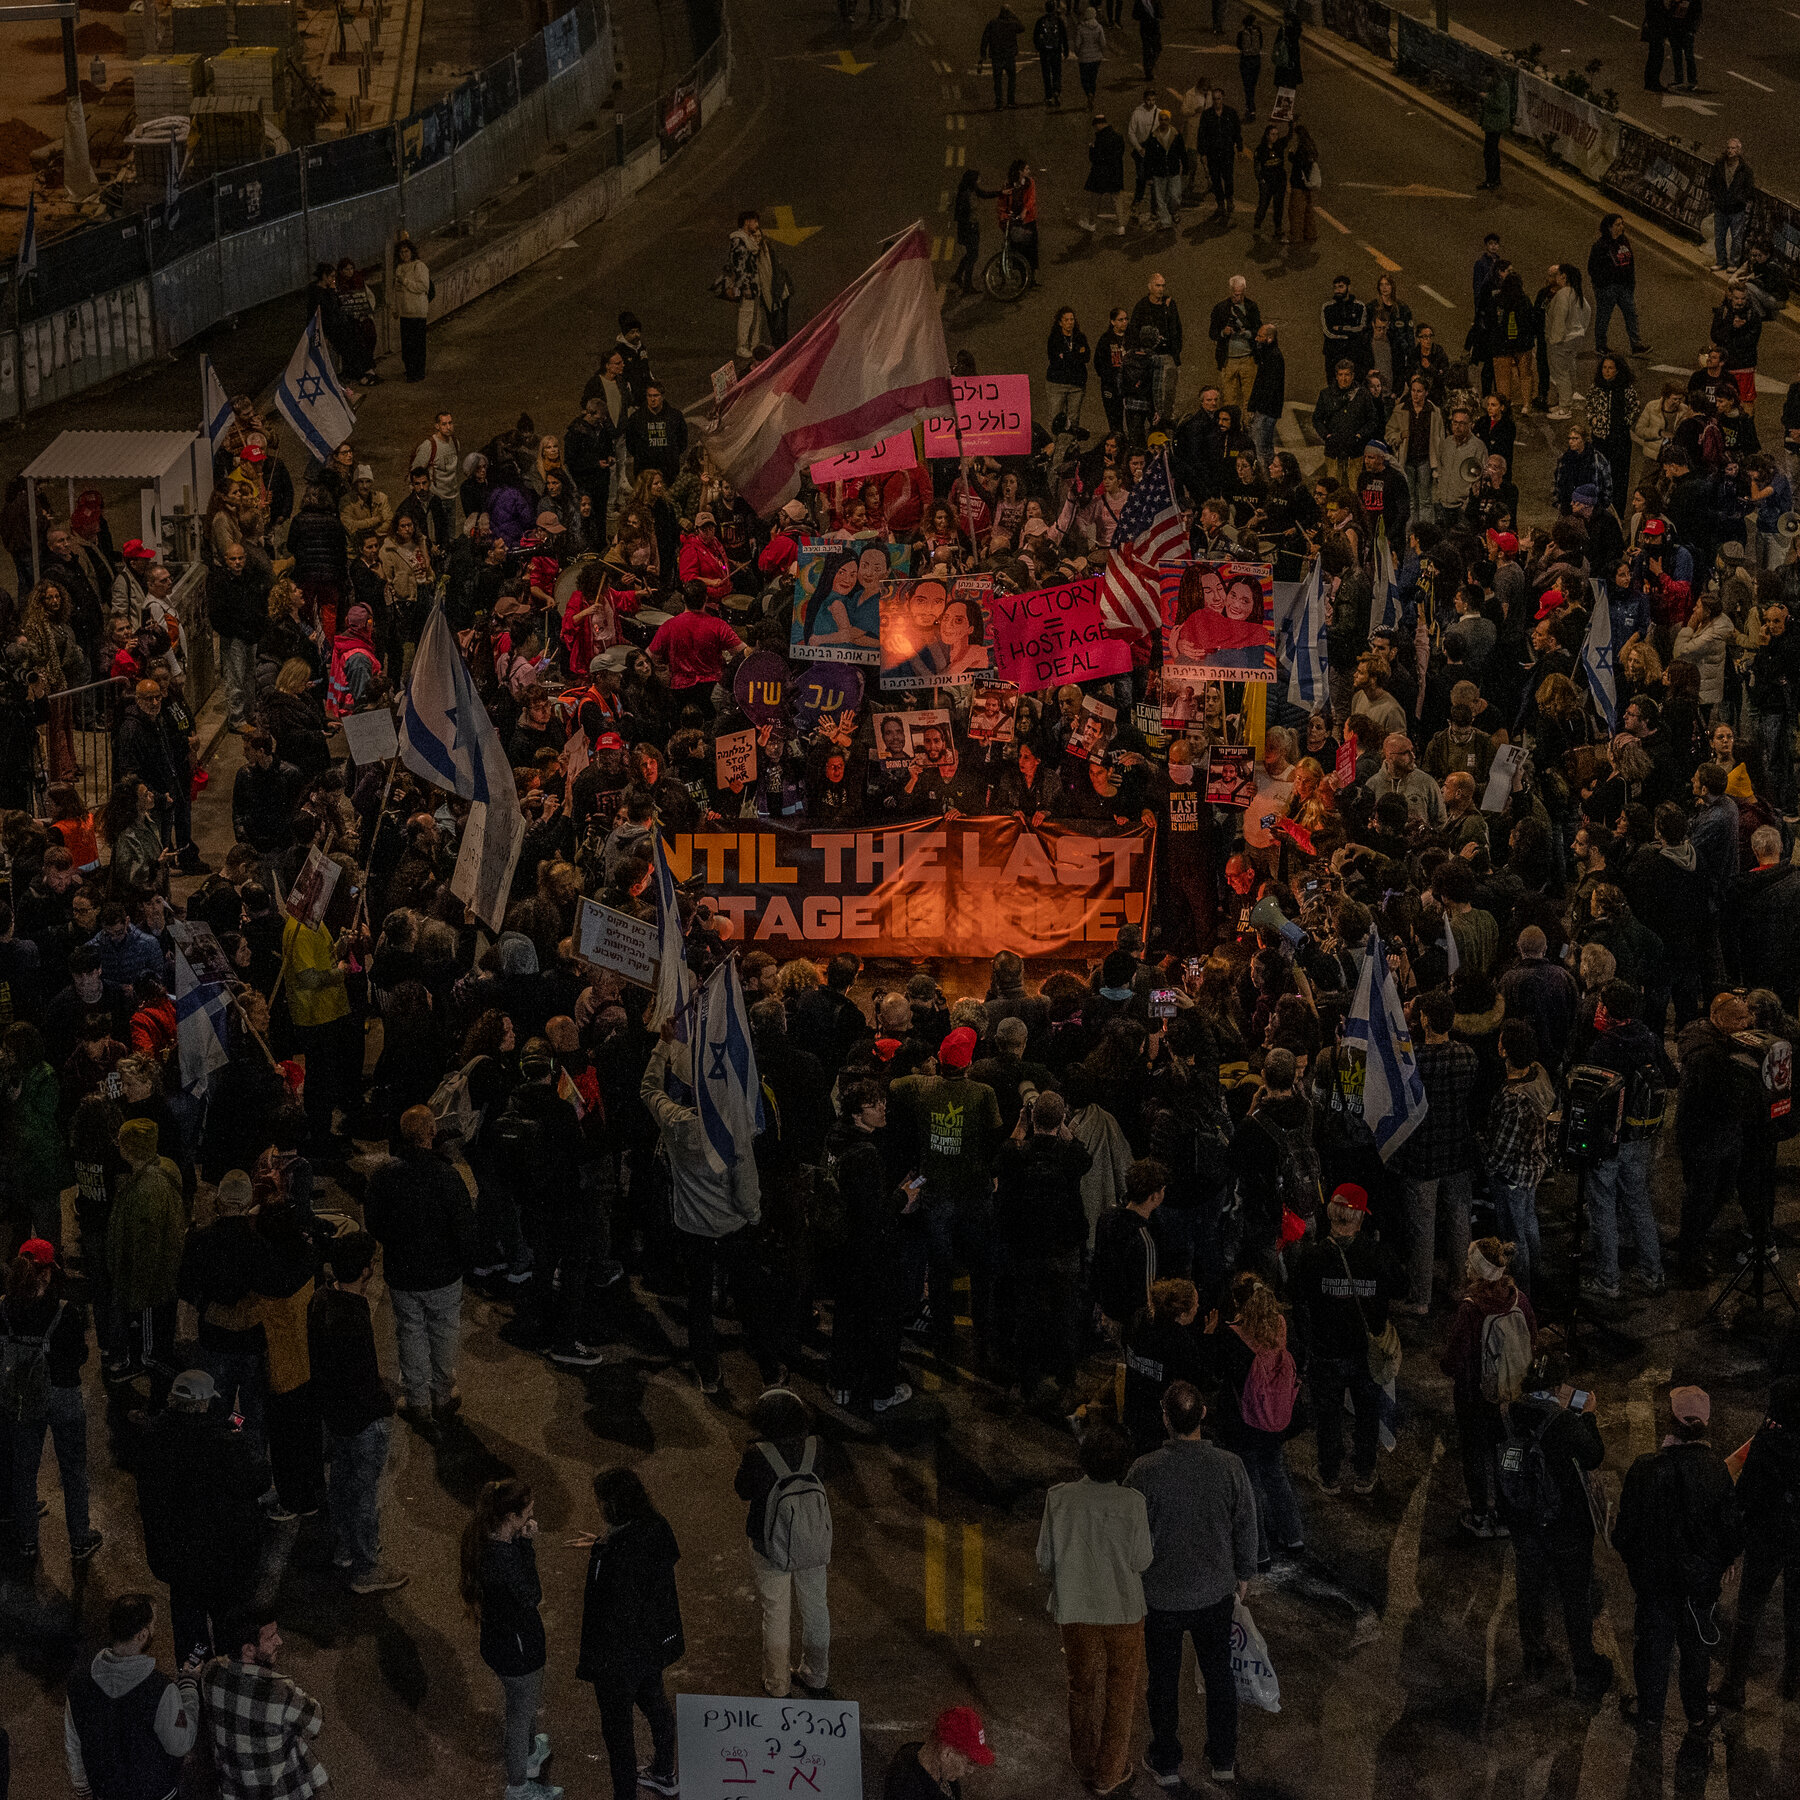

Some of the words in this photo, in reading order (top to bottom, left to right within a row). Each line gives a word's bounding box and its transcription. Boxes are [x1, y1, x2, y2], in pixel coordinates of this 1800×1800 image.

[999, 582, 1097, 622] VICTORY
[1010, 623, 1110, 660] HOSTAGE
[837, 650, 862, 660] אותה
[1036, 652, 1099, 681] DEAL
[1210, 669, 1237, 678] אותה
[1240, 671, 1275, 680] החזירו
[726, 753, 751, 766] STOP
[730, 763, 746, 772] THE
[725, 770, 750, 784] WAR
[1170, 792, 1185, 800] UNTIL
[1186, 792, 1198, 800] THE
[1170, 800, 1198, 813] LAST
[1170, 812, 1198, 822] HOSTAGE
[1171, 822, 1177, 831] IS
[661, 834, 798, 884] NTIL
[811, 832, 946, 884] THE
[962, 832, 1144, 888] LAST
[589, 904, 604, 918] לכל
[699, 895, 880, 940] TAGE
[891, 894, 946, 938] IS
[607, 915, 628, 928] מקום
[631, 924, 646, 936] כאן
[704, 1709, 762, 1732] אותם
[781, 1707, 853, 1738] להציל
